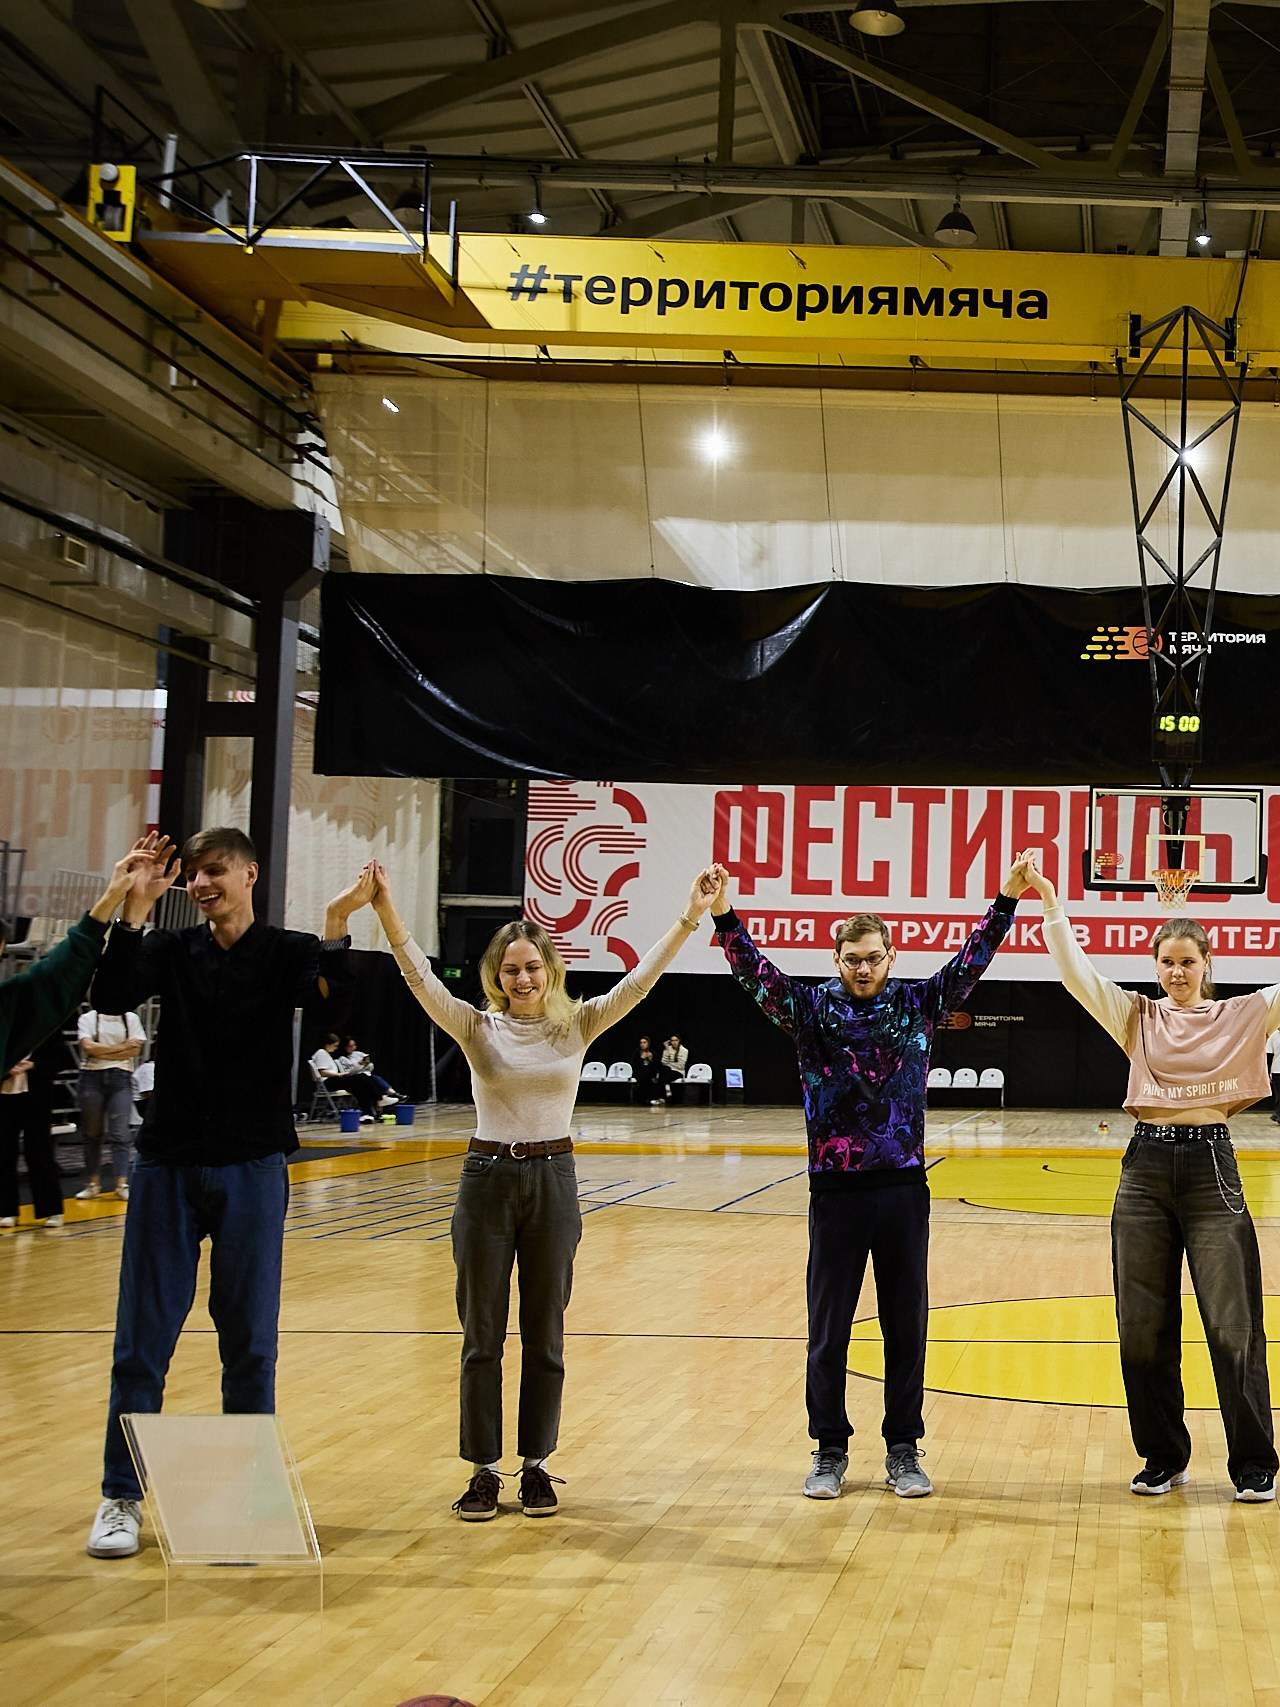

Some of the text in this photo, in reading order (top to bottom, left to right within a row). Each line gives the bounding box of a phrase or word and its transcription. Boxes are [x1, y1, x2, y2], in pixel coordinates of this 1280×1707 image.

[506, 263, 1049, 322] #территориямяча
[1168, 631, 1266, 644] ТЕРИТОРИЯ
[748, 917, 815, 944] ДЛЯ
[1142, 1078, 1239, 1099] PAINT MY SPIRIT PINK
